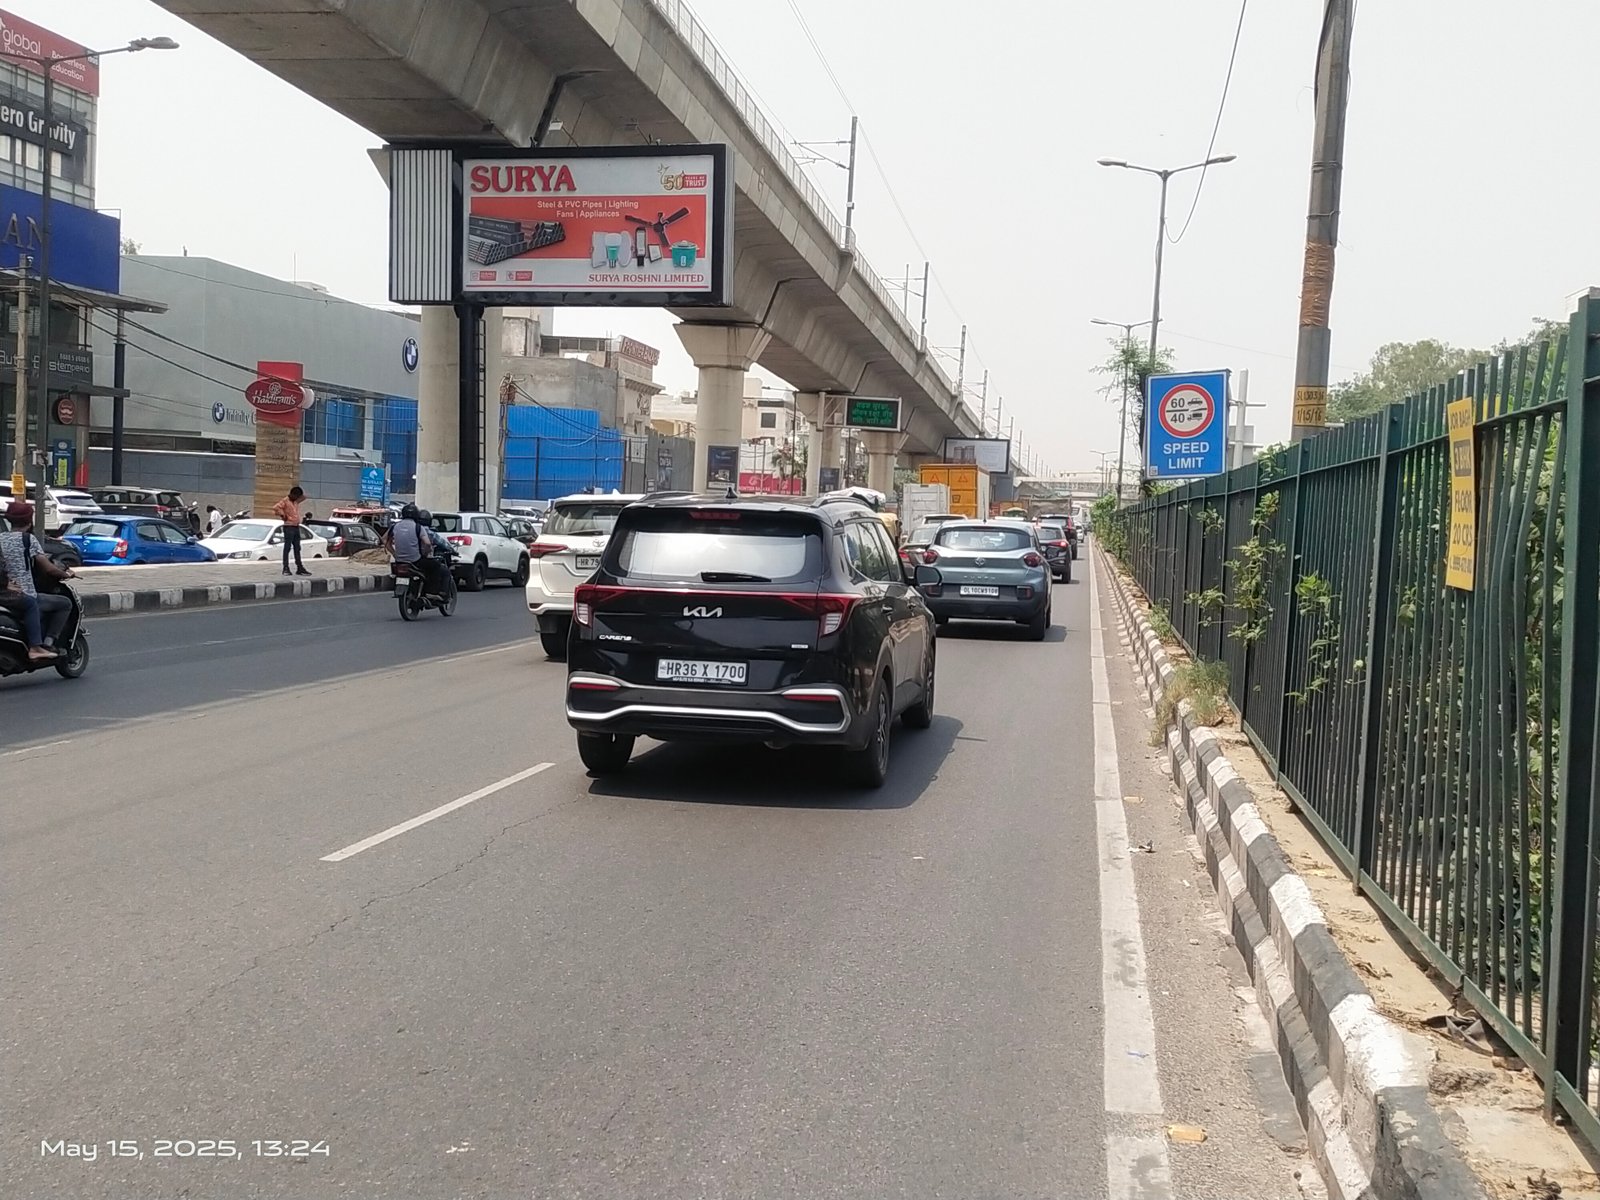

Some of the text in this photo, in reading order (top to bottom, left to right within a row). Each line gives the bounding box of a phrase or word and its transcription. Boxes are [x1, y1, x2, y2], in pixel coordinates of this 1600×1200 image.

[3, 29, 41, 55] global
[470, 165, 577, 193] SURYA
[582, 201, 602, 209] Pipes
[608, 201, 639, 210] Lighting
[580, 210, 620, 219] Appliances
[588, 274, 704, 283] SURYA ROSHNI LIMITED
[252, 389, 297, 405] Haldiram's
[1170, 398, 1185, 408] 60
[1170, 413, 1185, 423] 40
[1163, 442, 1210, 454] SPEED
[1168, 457, 1204, 469] LIMIT
[1453, 523, 1461, 544] 20
[683, 606, 723, 617] KIA
[666, 662, 745, 679] HR36 X 1700
